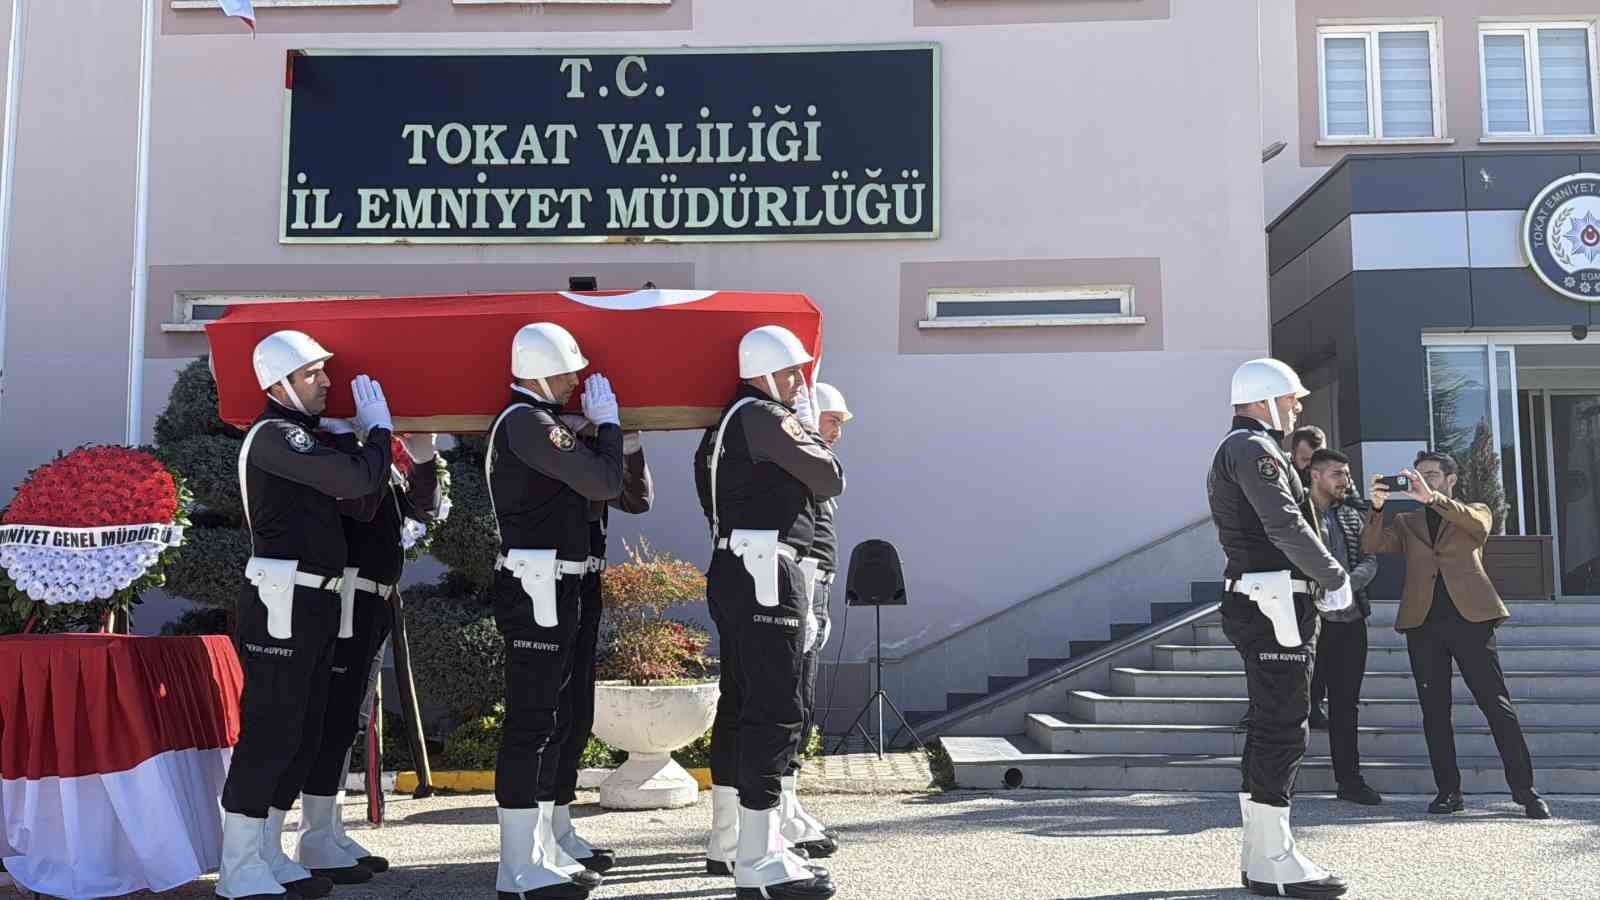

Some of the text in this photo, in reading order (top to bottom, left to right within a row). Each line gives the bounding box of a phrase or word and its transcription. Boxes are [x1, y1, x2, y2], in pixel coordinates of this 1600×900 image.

[559, 56, 665, 98] T.C.
[401, 104, 823, 165] TOKAT VALİLİĞİ
[290, 168, 926, 230] İL EMNİYET MÜDÜRLÜĞÜ
[1534, 208, 1549, 248] TOKAT
[53, 531, 97, 547] GENEL
